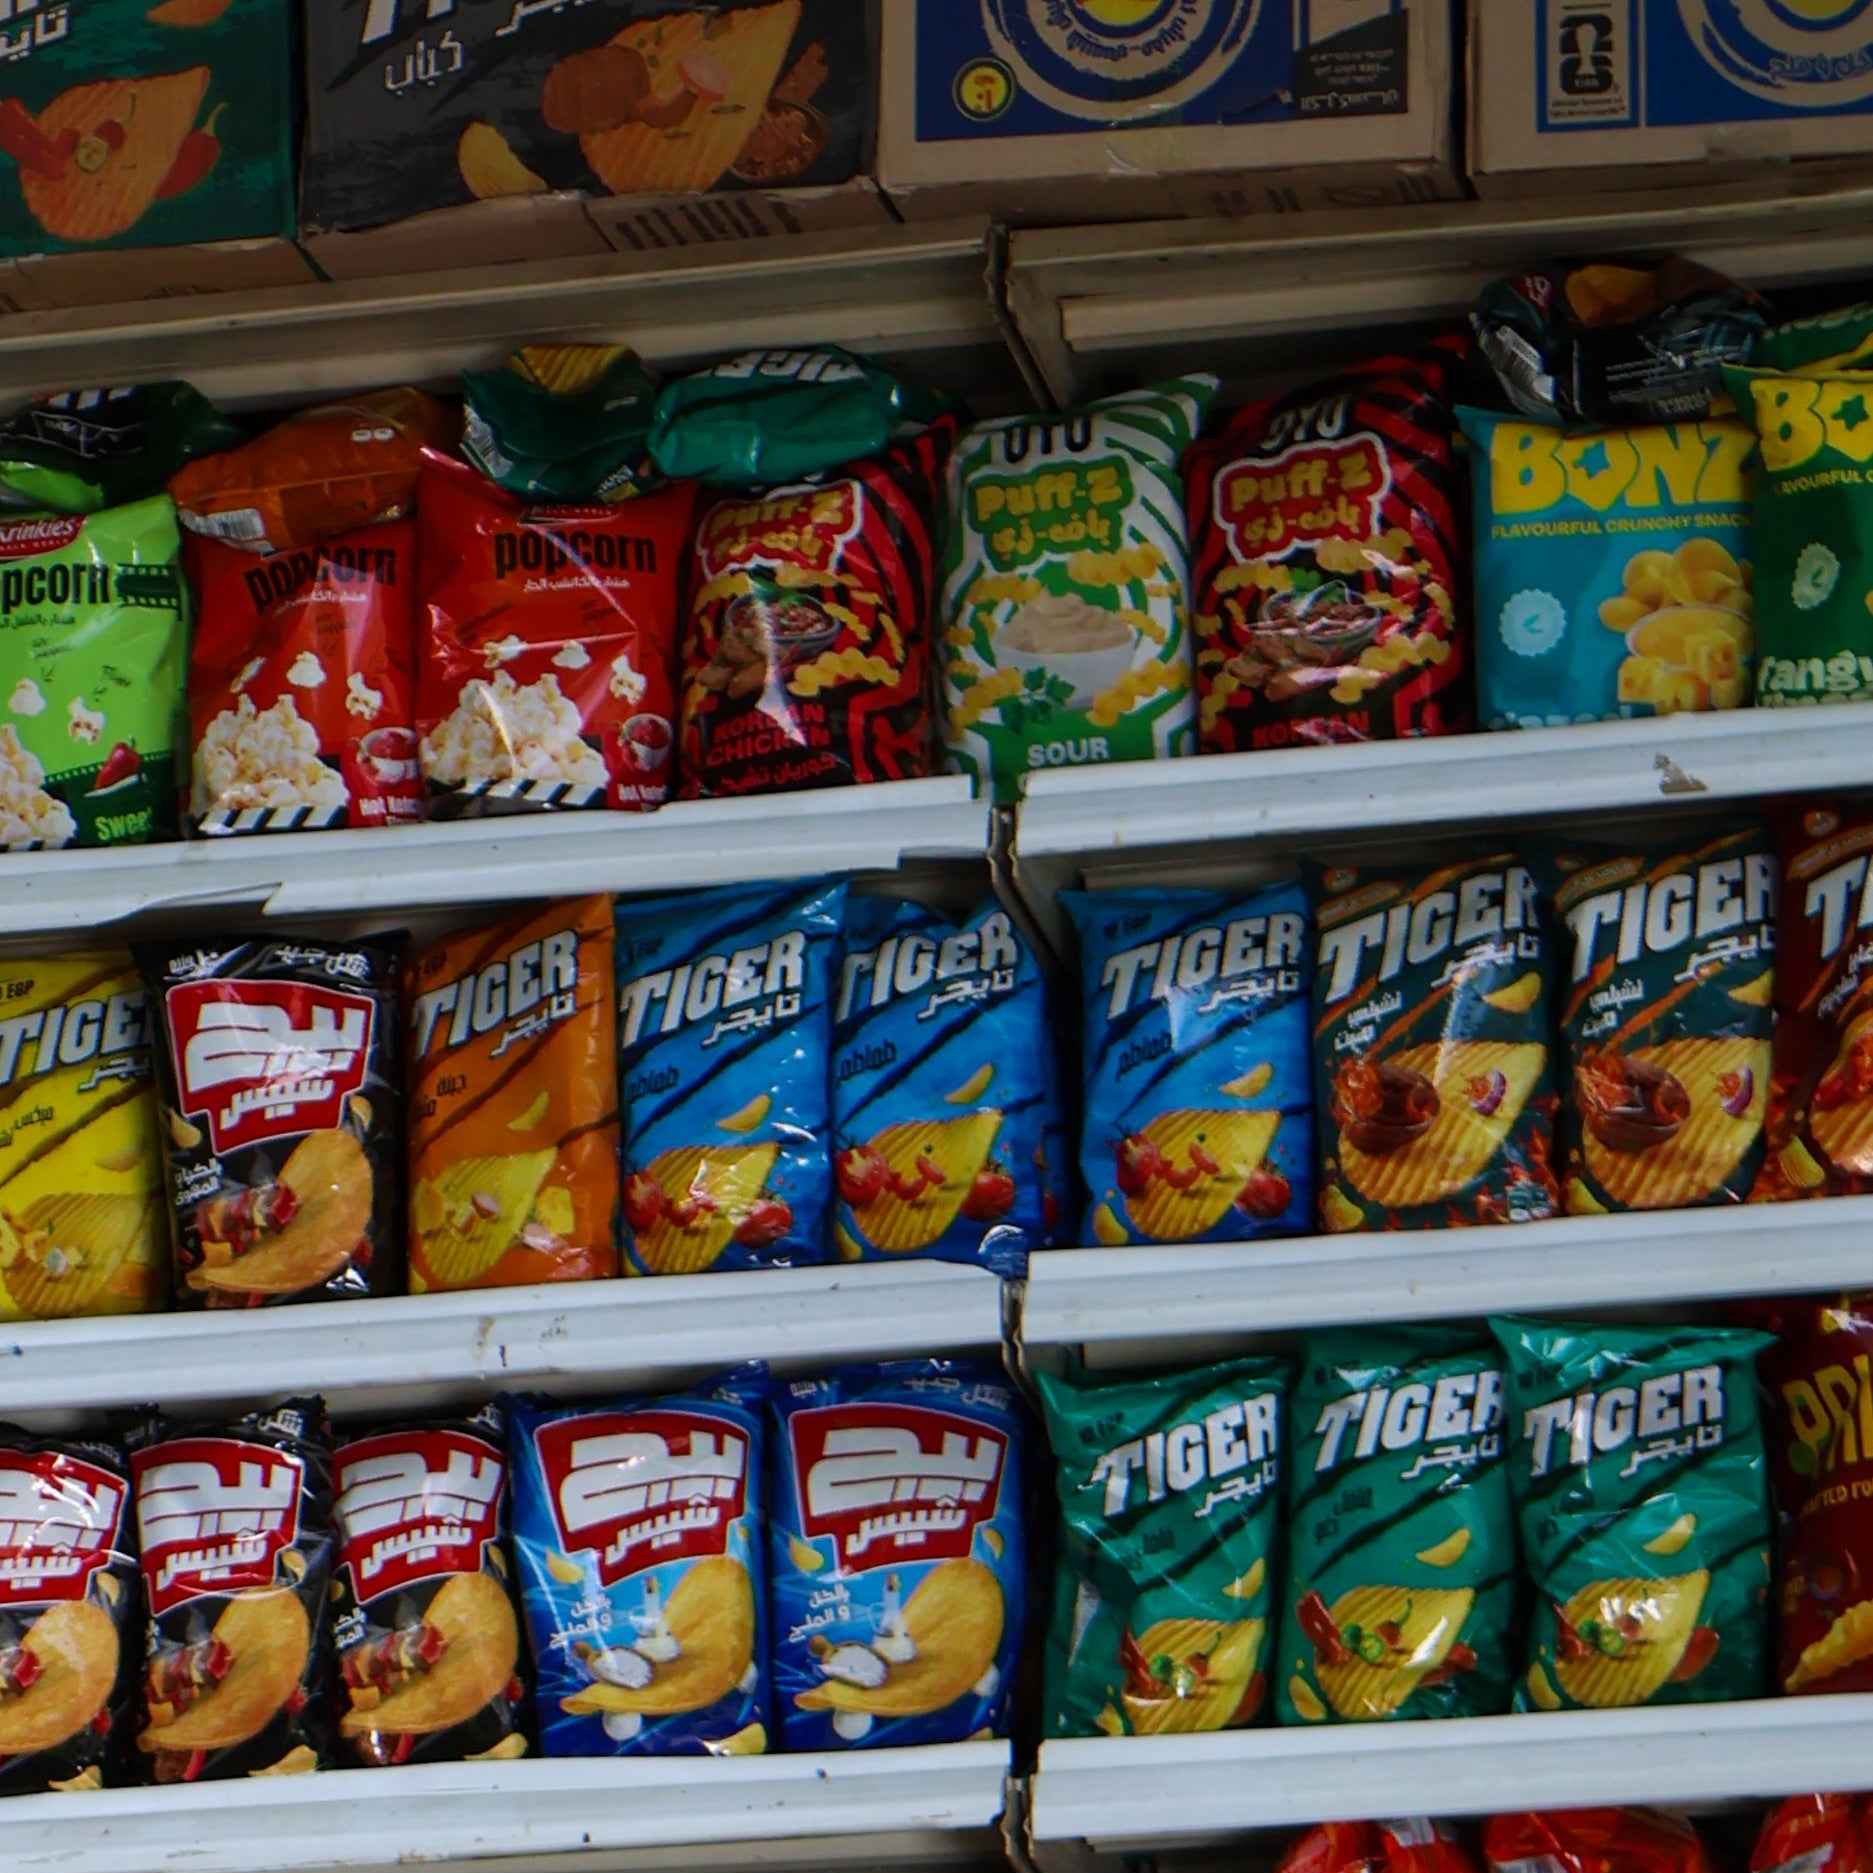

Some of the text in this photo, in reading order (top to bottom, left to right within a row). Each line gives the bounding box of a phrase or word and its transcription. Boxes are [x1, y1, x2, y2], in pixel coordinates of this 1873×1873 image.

[494, 530, 657, 579] popcorn
[1492, 516, 1689, 539] FLAVOURFUL CRUNCHY
[1027, 736, 1109, 767] SOUR
[414, 928, 580, 1060] TIGER
[619, 929, 807, 1049] TIGER
[835, 912, 1019, 1024] TIGER
[1102, 911, 1306, 1021] TIGER
[1079, 1392, 1278, 1518] TIGER
[1314, 1369, 1506, 1472] TIGER
[1526, 1364, 1726, 1478] TIGER
